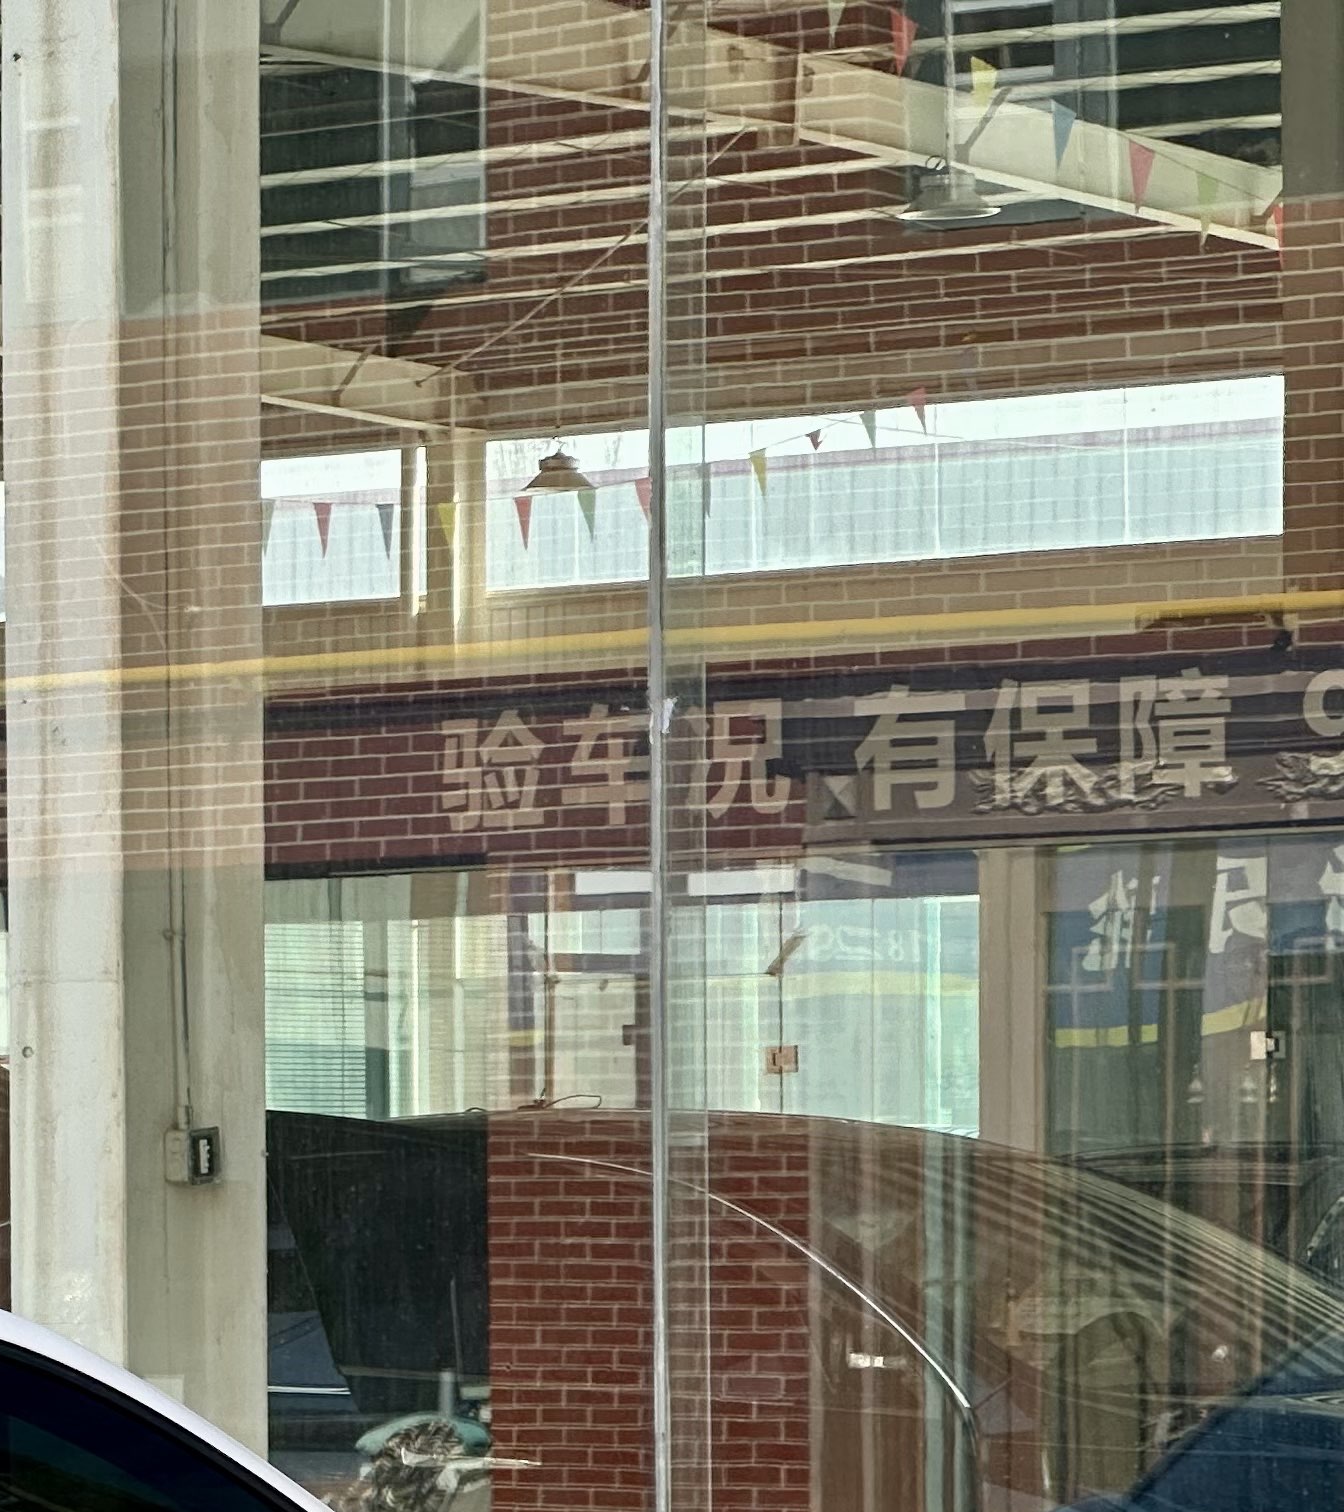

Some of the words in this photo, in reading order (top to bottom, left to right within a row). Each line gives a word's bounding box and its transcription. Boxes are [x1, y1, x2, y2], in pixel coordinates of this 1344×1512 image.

[439, 697, 792, 834] 验车况
[852, 666, 1234, 813] 有保障
